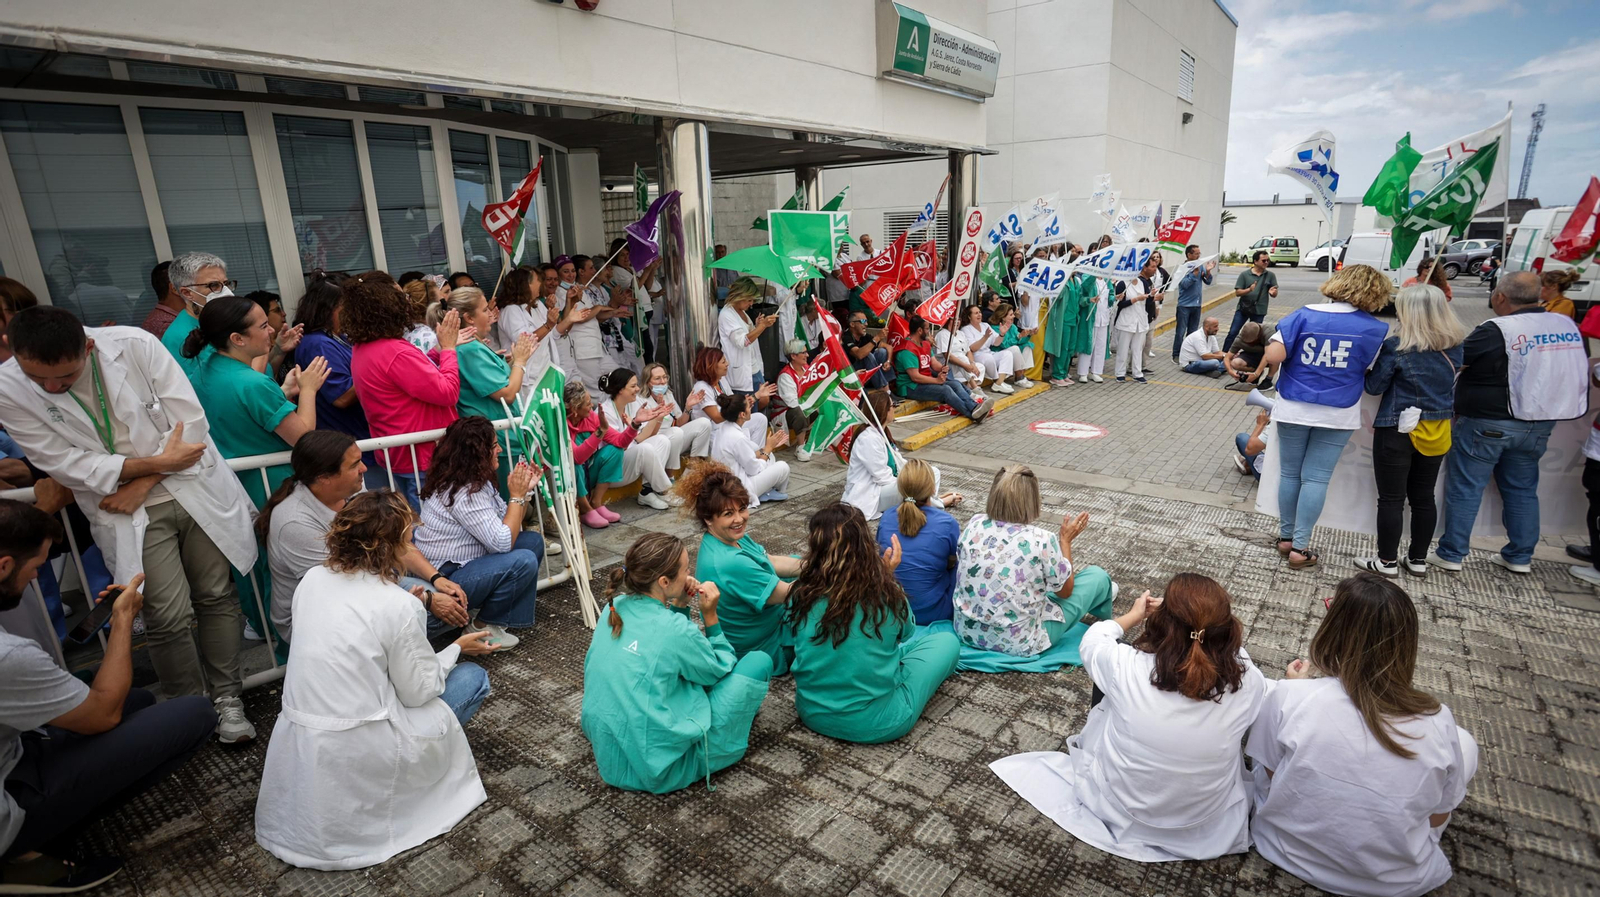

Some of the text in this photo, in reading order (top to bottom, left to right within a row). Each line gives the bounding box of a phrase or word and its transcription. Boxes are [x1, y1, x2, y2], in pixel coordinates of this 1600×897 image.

[933, 33, 959, 50] Dirección
[961, 43, 997, 65] Administración
[931, 48, 982, 72] A.G.S. Jerez, Costa Noroeste
[933, 60, 945, 72] Sierra
[944, 64, 950, 73] de
[950, 65, 962, 76] Cádiz
[1534, 333, 1581, 345] TECNOS
